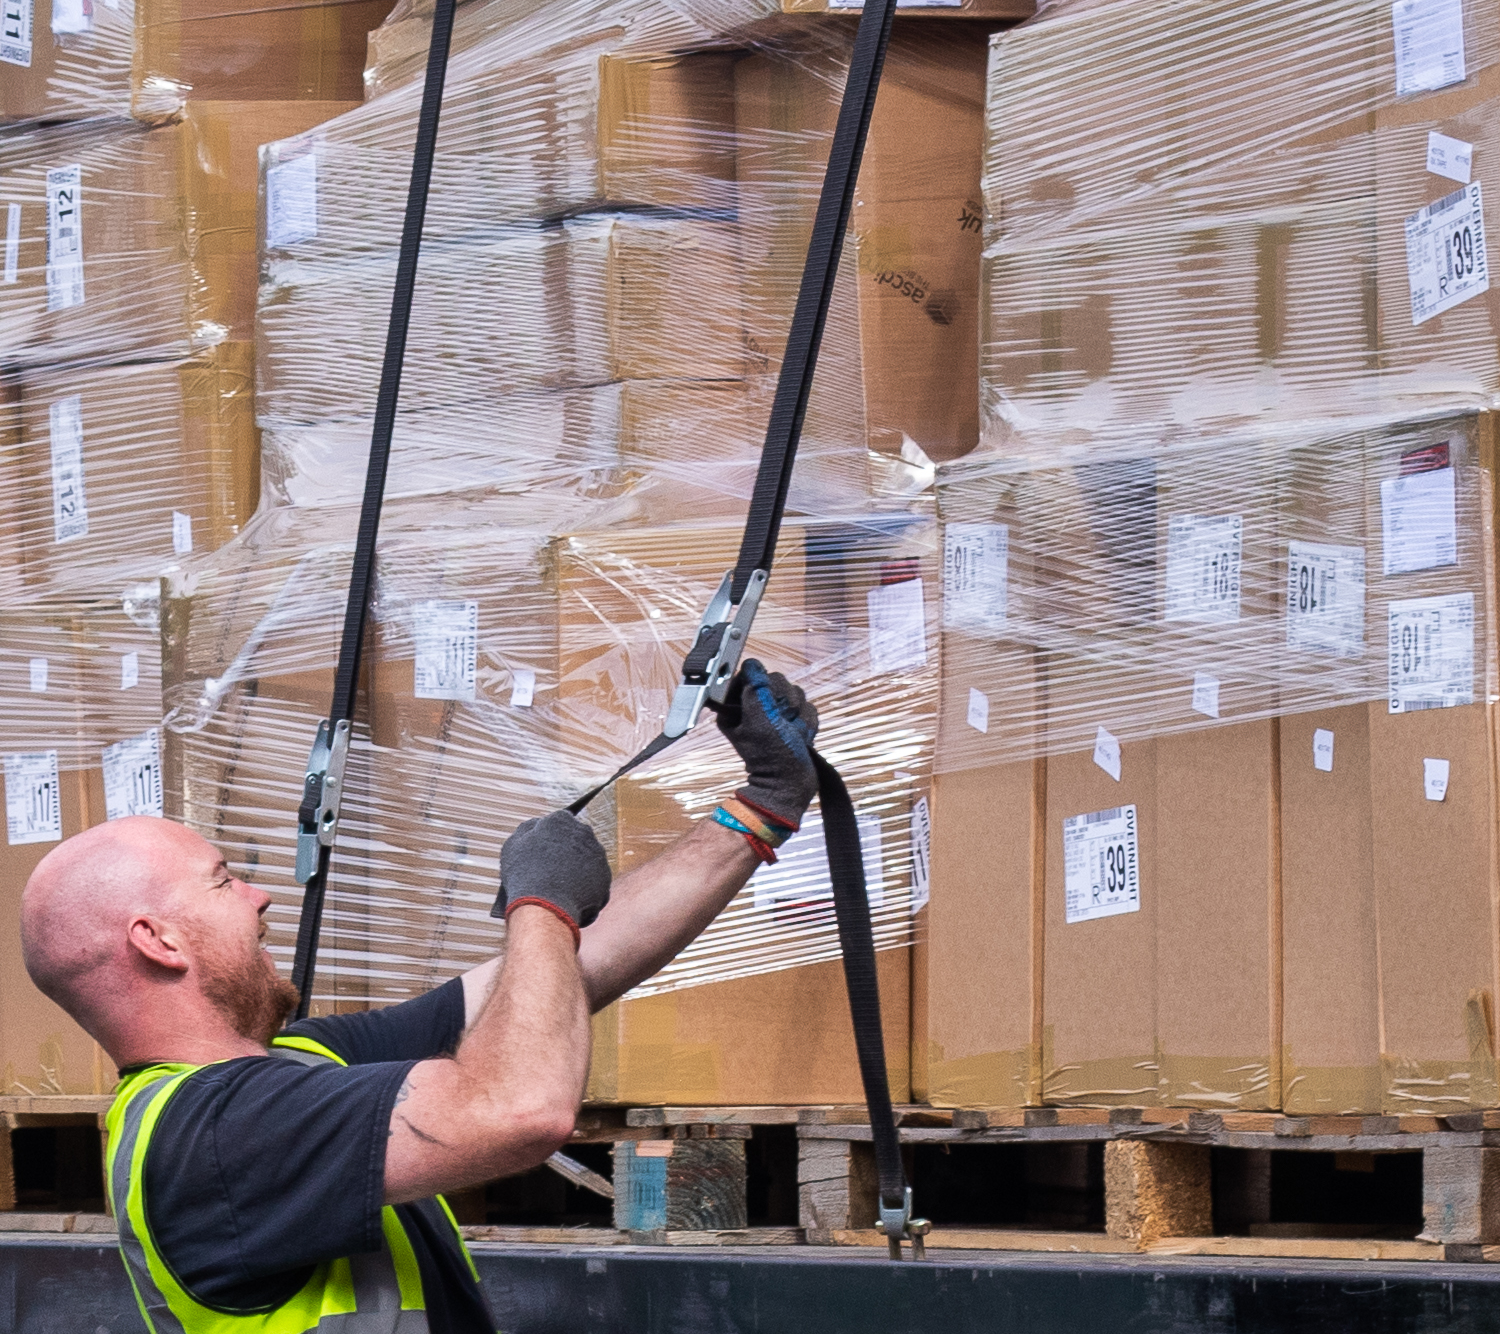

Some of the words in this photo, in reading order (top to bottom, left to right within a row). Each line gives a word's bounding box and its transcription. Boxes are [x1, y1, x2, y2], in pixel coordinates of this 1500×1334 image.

[5, 8, 21, 39] 11
[58, 189, 74, 222] 12
[1453, 224, 1475, 280] 39
[1470, 185, 1488, 285] OVERNIGHT
[1438, 276, 1449, 299] R
[1299, 564, 1318, 614] 18
[1390, 610, 1400, 709] OVERNIGHT
[37, 782, 51, 823] 17
[1106, 843, 1127, 893] 39
[1124, 808, 1138, 903] OVERNIGHT
[1091, 883, 1101, 905] R
